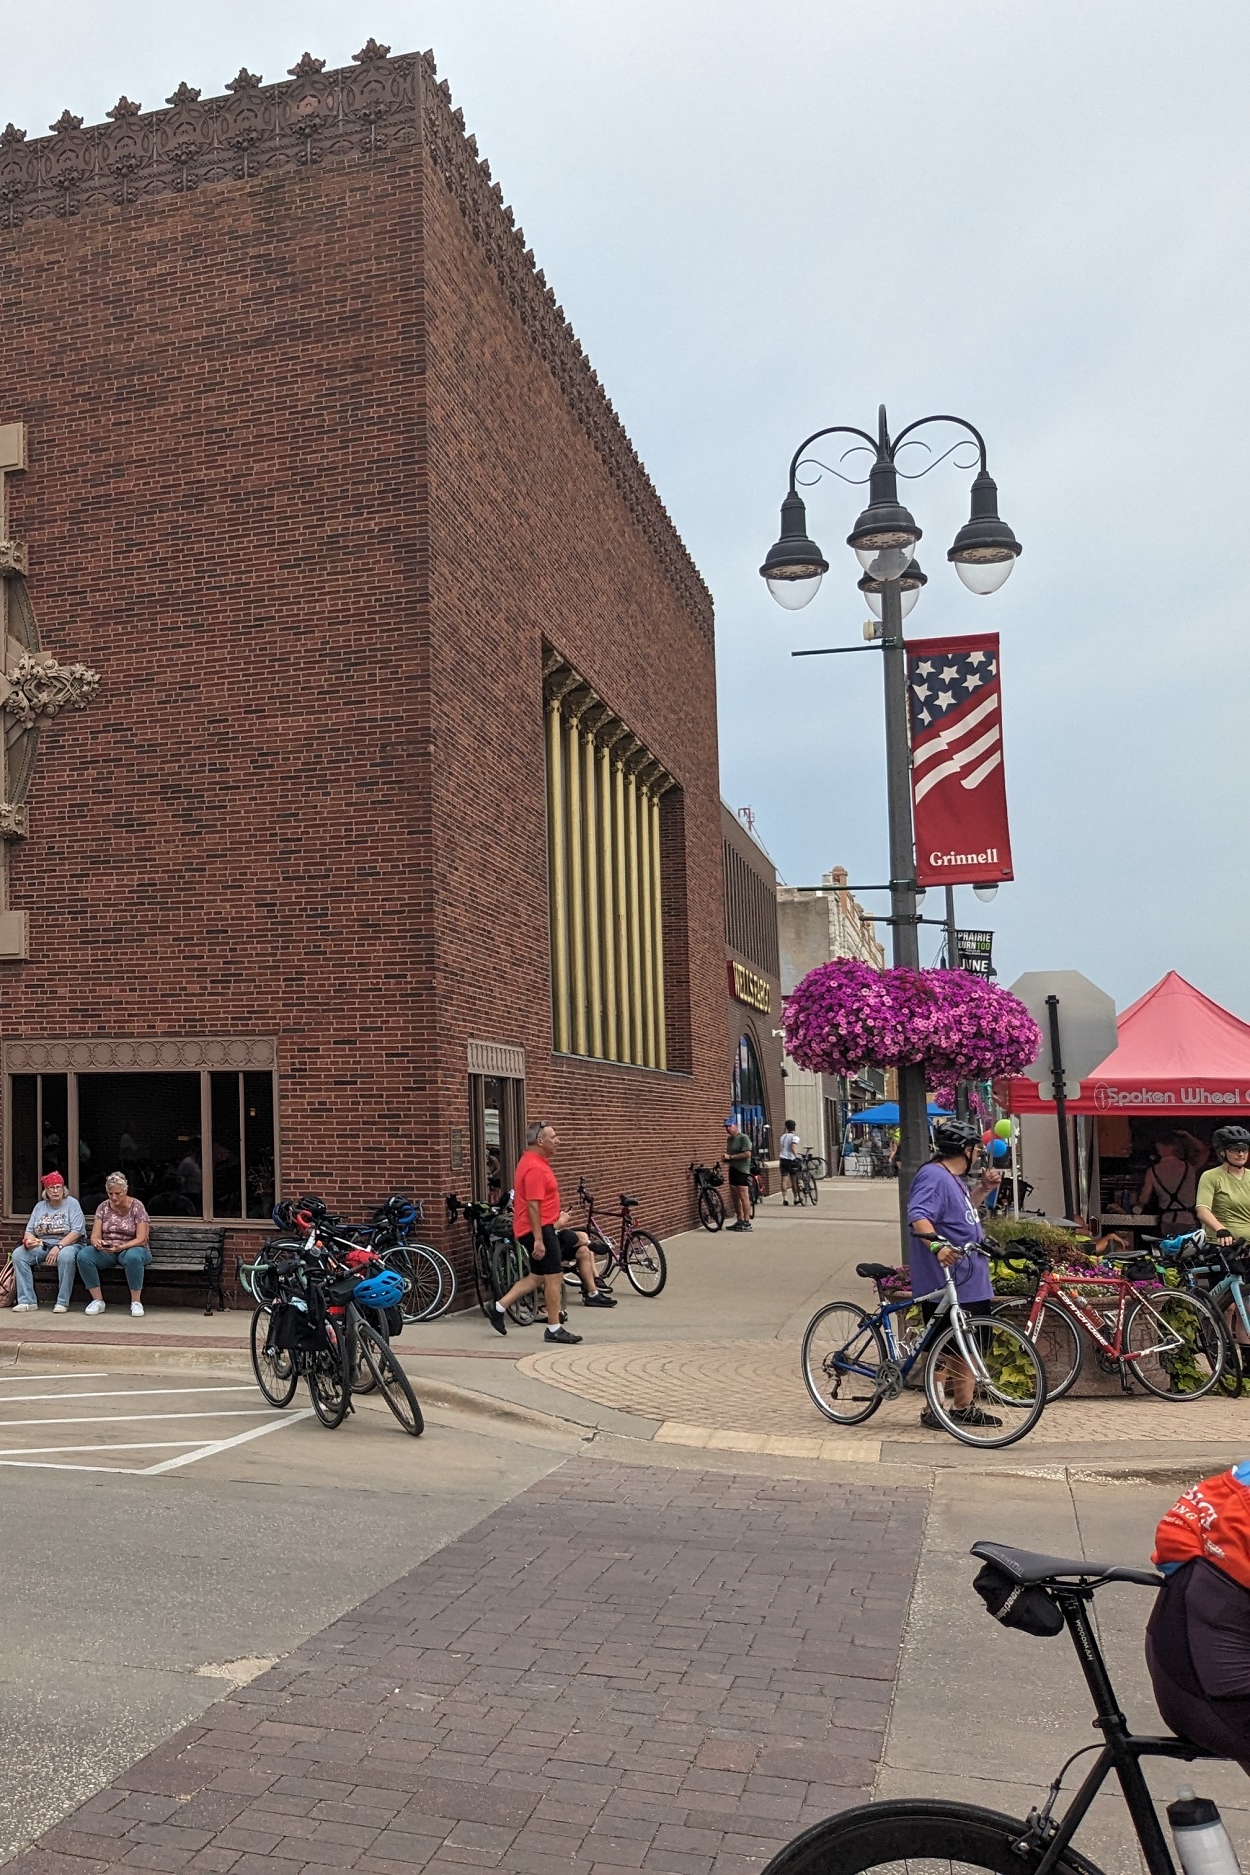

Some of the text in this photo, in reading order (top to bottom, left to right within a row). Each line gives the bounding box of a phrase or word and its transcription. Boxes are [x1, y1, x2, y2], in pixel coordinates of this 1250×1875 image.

[929, 848, 998, 867] Grinnell
[957, 931, 991, 942] PRAIRIE
[959, 958, 989, 972] JUNE
[1106, 1087, 1176, 1107] Spoken
[1180, 1087, 1241, 1104] Wheel
[1056, 1290, 1109, 1347] cannondale
